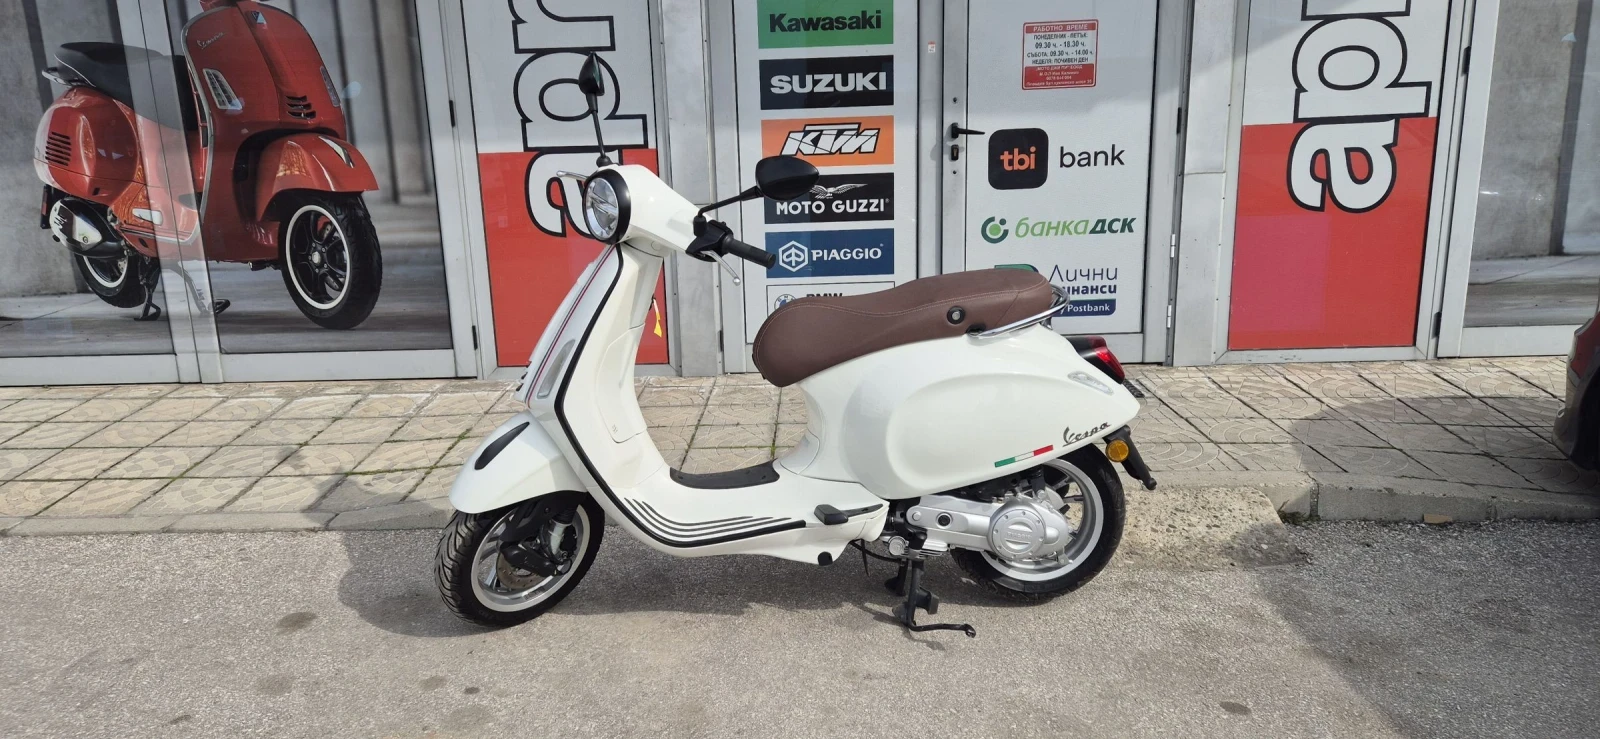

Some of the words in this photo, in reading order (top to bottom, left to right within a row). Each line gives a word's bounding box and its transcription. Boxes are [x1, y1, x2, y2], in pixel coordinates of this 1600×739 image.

[770, 9, 882, 33] Kawasaki
[1035, 41, 1051, 49] 09.30
[1064, 40, 1079, 48] 18.30
[770, 71, 887, 94] SUZUKI
[1286, 0, 1432, 213] ap
[781, 122, 882, 156] KTM
[999, 147, 1037, 172] tbi
[1059, 144, 1125, 168] bank
[776, 200, 825, 215] MOTO
[831, 198, 885, 214] GUZZI
[811, 247, 882, 262] PIAGGIO
[1048, 264, 1118, 283] Лични
[1062, 284, 1117, 295] инанси
[1067, 303, 1110, 313] Postbank
[1062, 421, 1111, 447] Vespa
